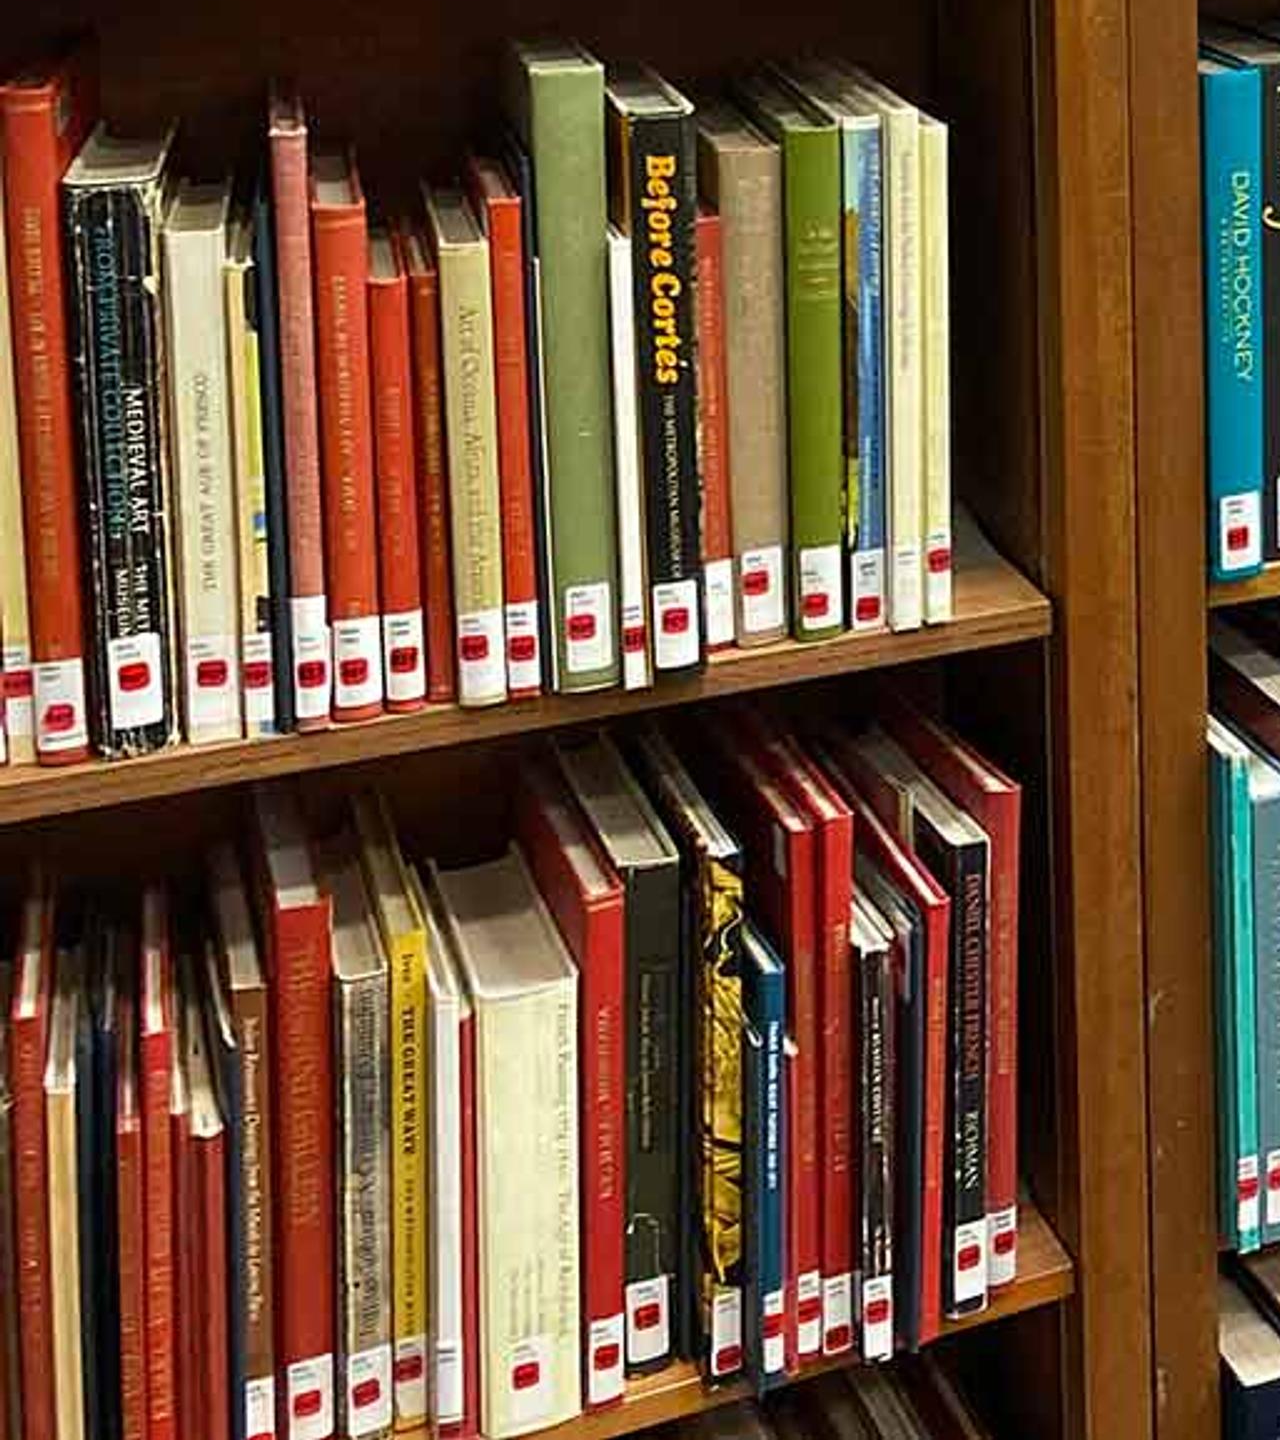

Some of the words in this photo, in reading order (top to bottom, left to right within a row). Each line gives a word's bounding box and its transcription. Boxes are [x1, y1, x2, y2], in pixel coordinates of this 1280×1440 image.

[639, 154, 681, 268] Before
[1233, 172, 1252, 247] DAVID
[97, 294, 122, 381] PRIVATE
[651, 272, 690, 383] Cortés
[1233, 255, 1253, 381] HOCKNEY
[104, 388, 128, 538] COLLECTIONS
[125, 387, 148, 489] MEDIEVAL
[664, 420, 680, 507] METROPOLITAN
[129, 496, 150, 537] ART
[199, 500, 217, 555] GREAT
[133, 564, 150, 593] THE
[202, 560, 219, 591] THE
[964, 874, 981, 929] DANIEL
[965, 935, 981, 1009] CHESTER
[402, 1046, 417, 1103] GREAT
[965, 1014, 981, 1080] FRENCH
[402, 1108, 417, 1155] WAVE
[965, 1111, 982, 1187] RICHMAN
